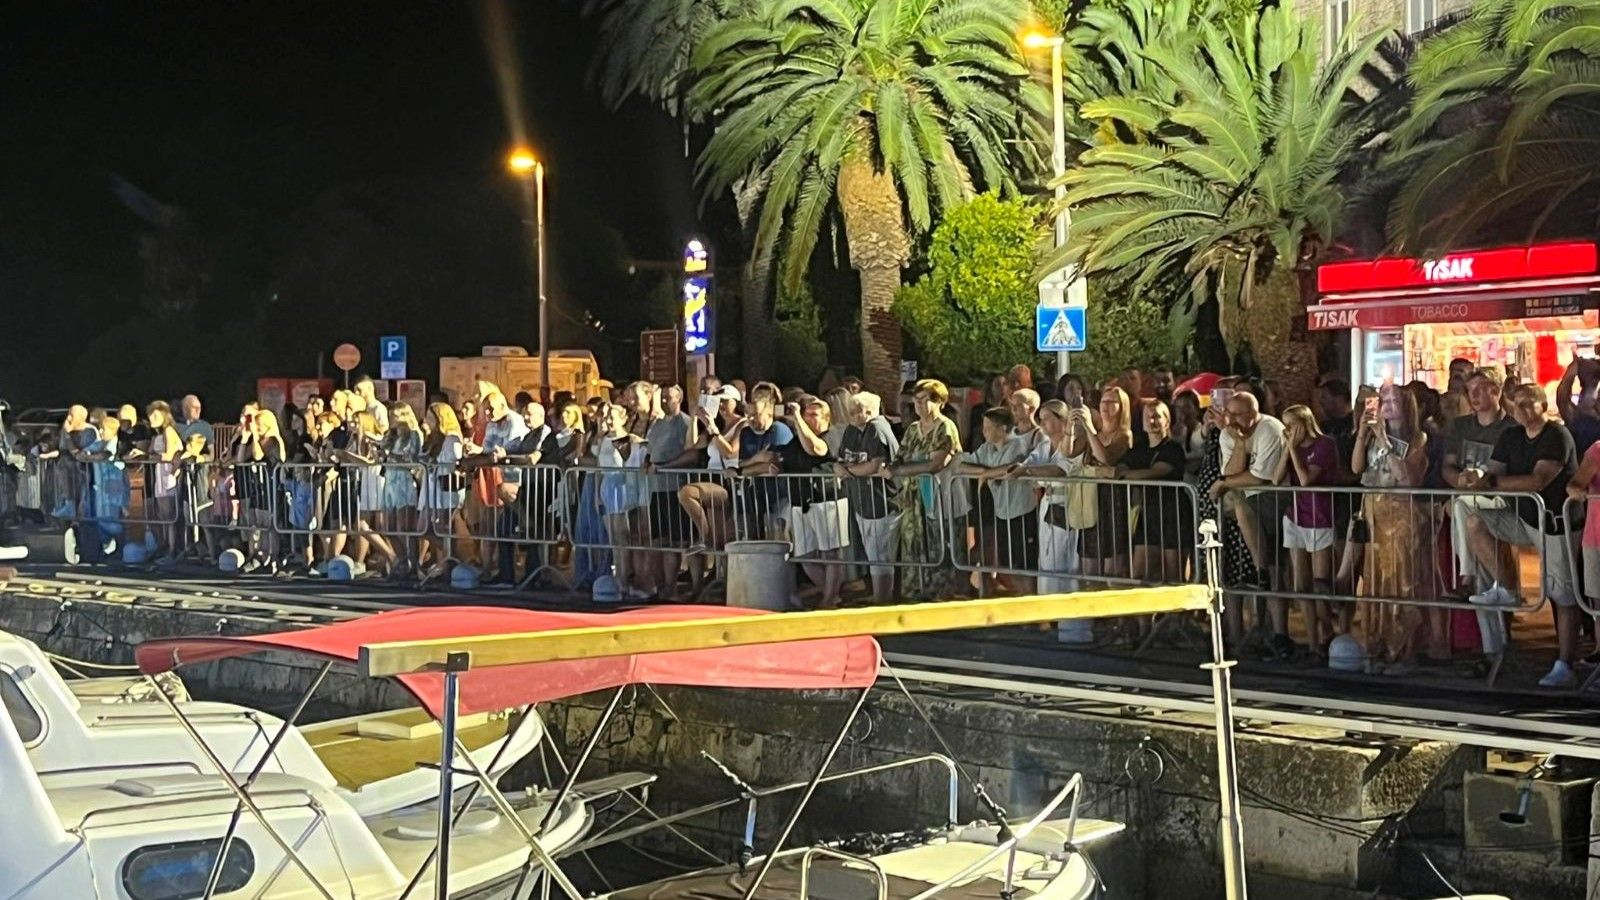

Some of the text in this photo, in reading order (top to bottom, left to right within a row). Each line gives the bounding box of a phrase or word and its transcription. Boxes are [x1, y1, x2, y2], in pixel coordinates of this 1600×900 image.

[1423, 257, 1474, 281] TISAK
[1313, 309, 1359, 328] TISAK
[1410, 303, 1469, 319] TOBACCO
[387, 341, 400, 358] P
